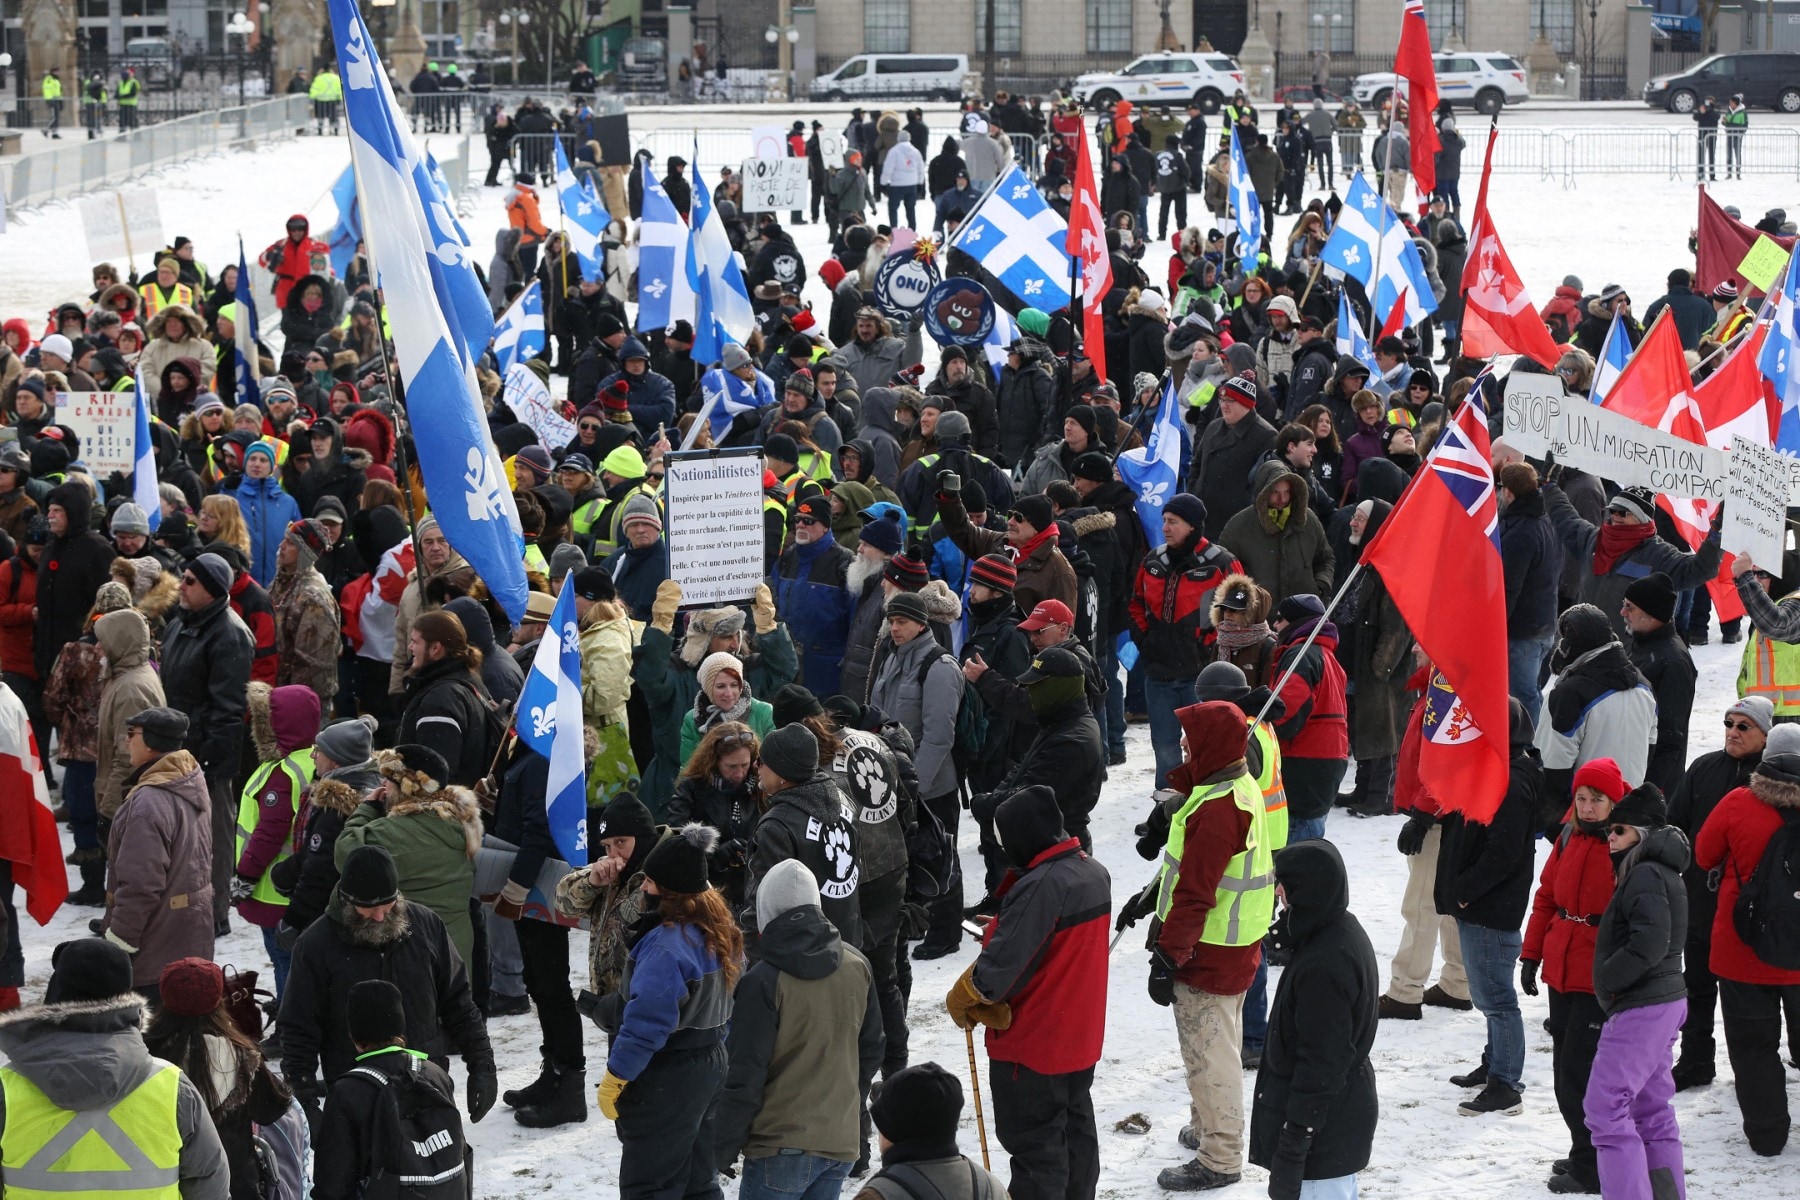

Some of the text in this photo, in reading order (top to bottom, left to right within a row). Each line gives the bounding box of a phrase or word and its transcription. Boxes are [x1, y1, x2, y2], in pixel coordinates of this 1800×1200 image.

[748, 160, 783, 178] NON!
[751, 178, 801, 192] PACTE DE
[896, 275, 928, 293] ONU
[90, 394, 116, 405] RIP
[75, 407, 132, 417] CANADA
[1506, 392, 1561, 439] STOP
[1550, 438, 1568, 457] the
[1603, 434, 1703, 473] MIGRATION
[76, 437, 131, 447] NVASIO
[87, 448, 121, 457] PACT
[671, 463, 759, 482] Nationalitistes!
[1729, 467, 1741, 481] will
[1743, 475, 1754, 489] call
[1731, 453, 1739, 462] of
[1742, 456, 1756, 474] the
[1759, 464, 1787, 495] future
[672, 494, 699, 504] Inspirée
[701, 494, 712, 503] par
[714, 492, 723, 500] les
[673, 511, 694, 523] portée
[697, 512, 708, 521] par
[717, 508, 743, 518] cupidité
[745, 508, 752, 516] de
[717, 541, 732, 549] n'est
[733, 541, 744, 549] pas
[672, 562, 689, 570] relle.
[690, 560, 708, 568] C'est
[722, 556, 749, 566] nouvelle
[750, 555, 763, 563] for-
[683, 575, 717, 585] d'invasion
[726, 571, 763, 581] d'esclavage.
[686, 589, 708, 600] Vérité
[710, 589, 726, 598] nous
[728, 586, 757, 596] délivrer
[866, 807, 890, 821] CLAN
[828, 883, 852, 896] CLAN
[411, 1129, 453, 1157] PUMA
